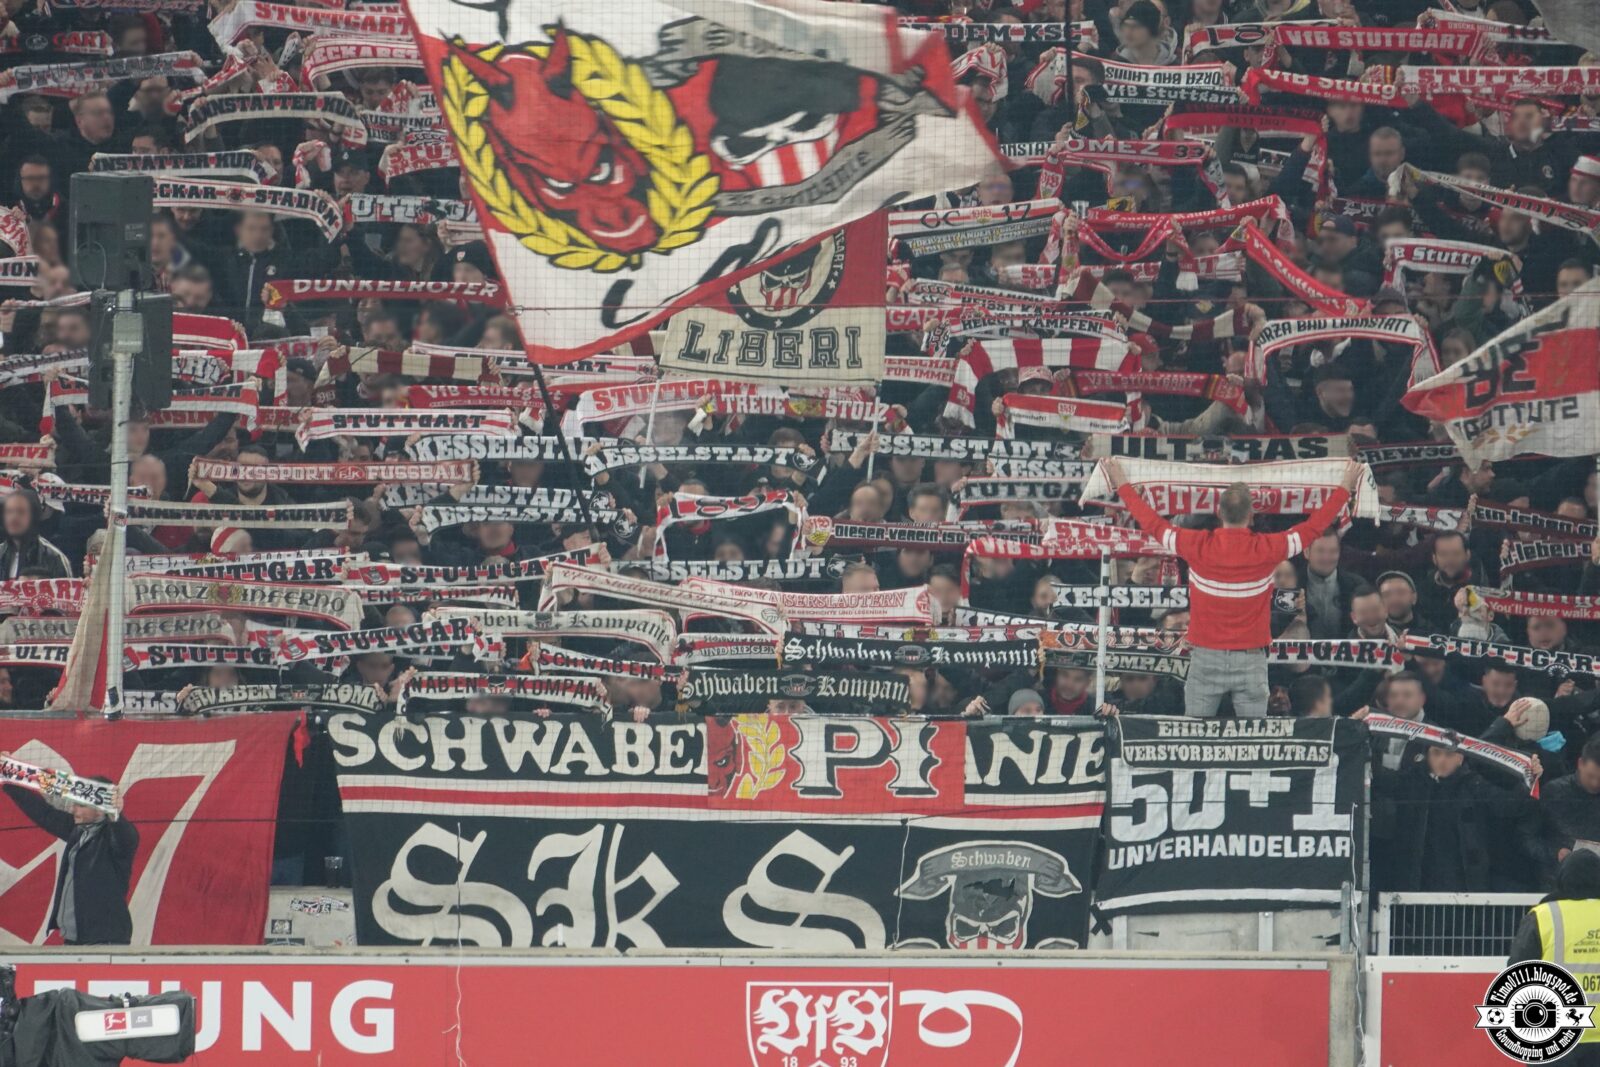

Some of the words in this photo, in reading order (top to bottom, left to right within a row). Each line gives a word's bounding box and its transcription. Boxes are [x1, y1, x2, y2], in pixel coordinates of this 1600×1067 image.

[1286, 30, 1331, 47] VfB
[1338, 30, 1470, 51] STUTTGART
[1102, 83, 1138, 98] VfB
[1146, 86, 1239, 105] Stuttgart
[255, 188, 339, 227] STADION
[1001, 203, 1032, 222] 17
[293, 279, 499, 298] DUNKELROTER
[678, 319, 863, 369] LIBERI
[721, 394, 786, 415] TREUE
[332, 413, 486, 429] STUTTGART
[830, 429, 1051, 460] KSSELSTADT
[198, 463, 334, 481] VOLKSSPORT
[401, 548, 592, 584] STUTTGART
[135, 582, 210, 602] PFALZ
[241, 587, 345, 613] INFERNO
[1524, 604, 1560, 618] never
[1562, 605, 1592, 619] walk
[784, 637, 892, 664] Schwaben
[1158, 719, 1220, 738] EHRE
[1226, 718, 1297, 737] ALLEN
[1124, 744, 1261, 763] VERSTORBENEN
[1262, 744, 1330, 762] ULTRAS
[1110, 757, 1351, 843] 50+1
[951, 850, 1032, 868] Schwaben
[1108, 835, 1351, 870] UNVERHANDELBAR
